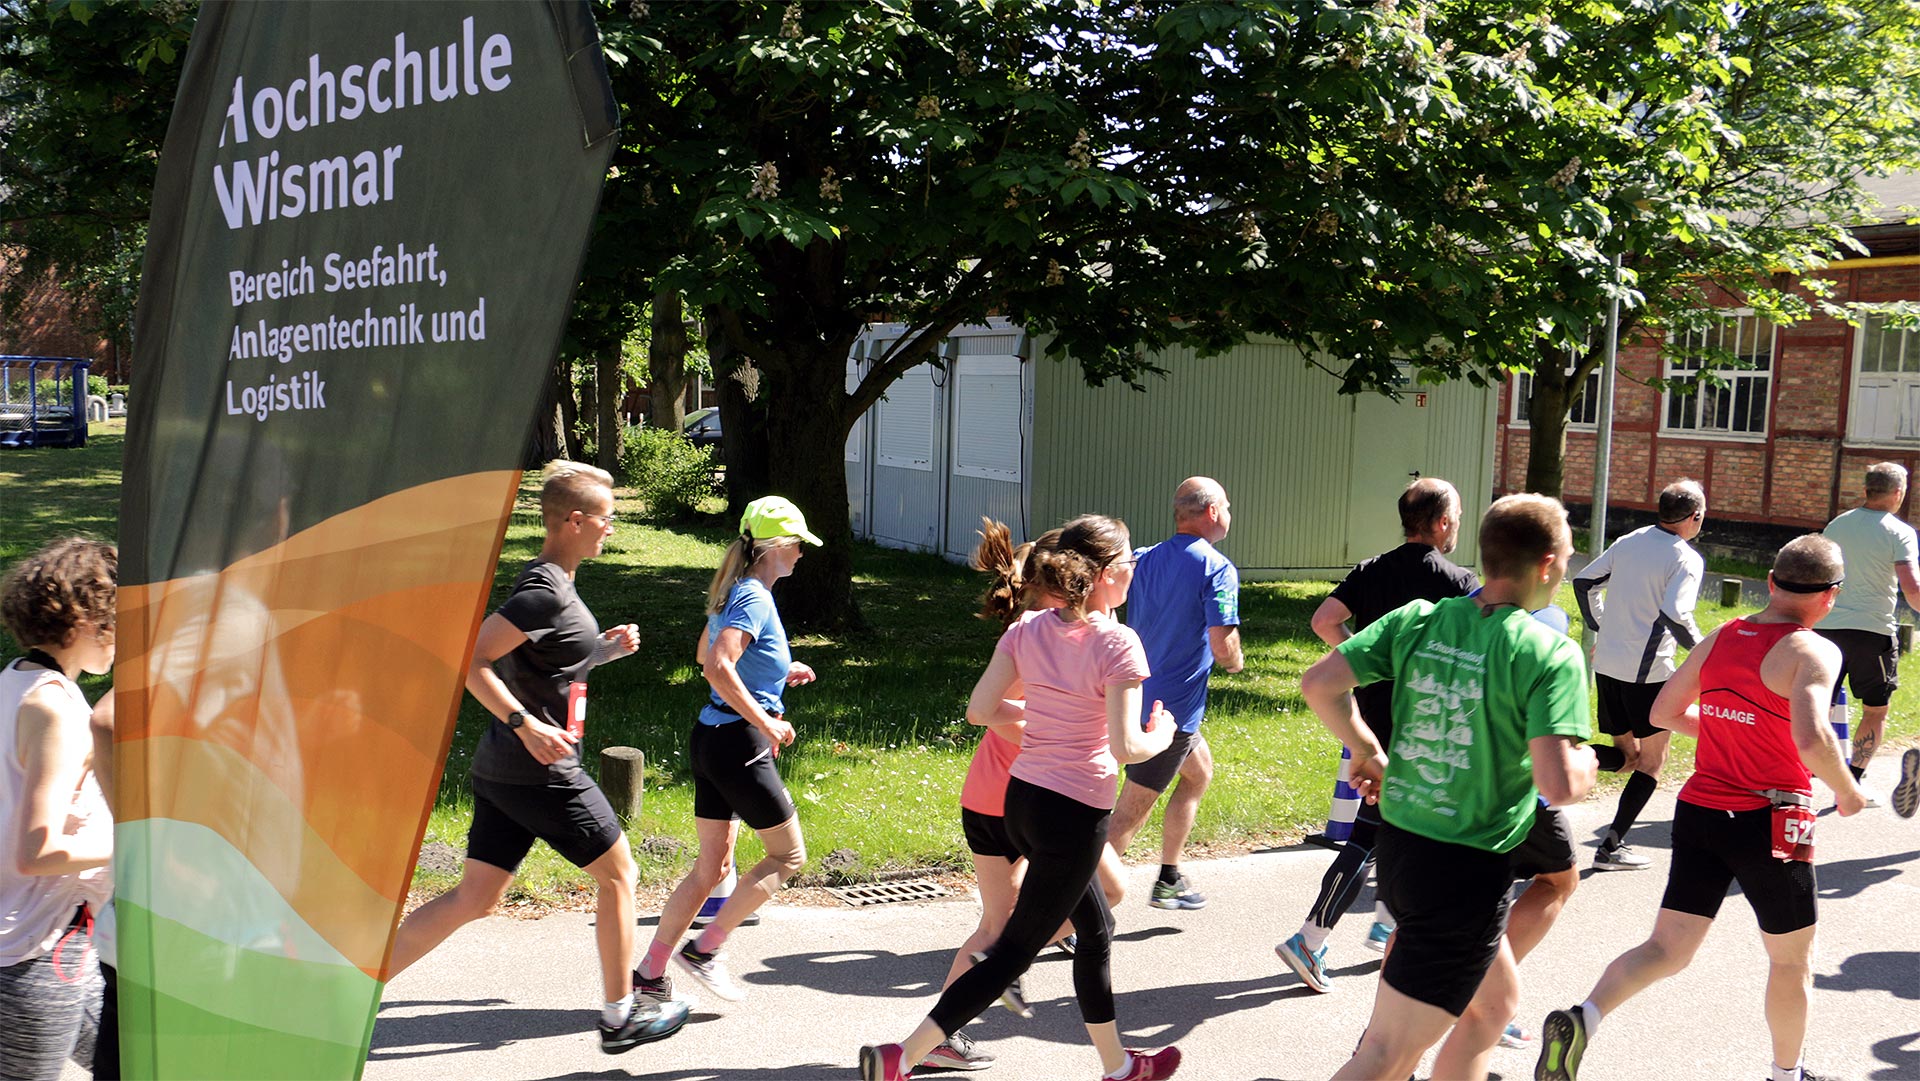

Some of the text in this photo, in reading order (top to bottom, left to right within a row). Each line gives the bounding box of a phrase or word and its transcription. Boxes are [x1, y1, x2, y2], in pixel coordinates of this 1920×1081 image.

[213, 144, 403, 230] Wismar
[228, 242, 447, 307] Bereich Seefahrt,
[228, 296, 486, 364] Anlagentechnik und
[226, 370, 326, 422] Logistik
[1702, 703, 1756, 726] SC LAAGE
